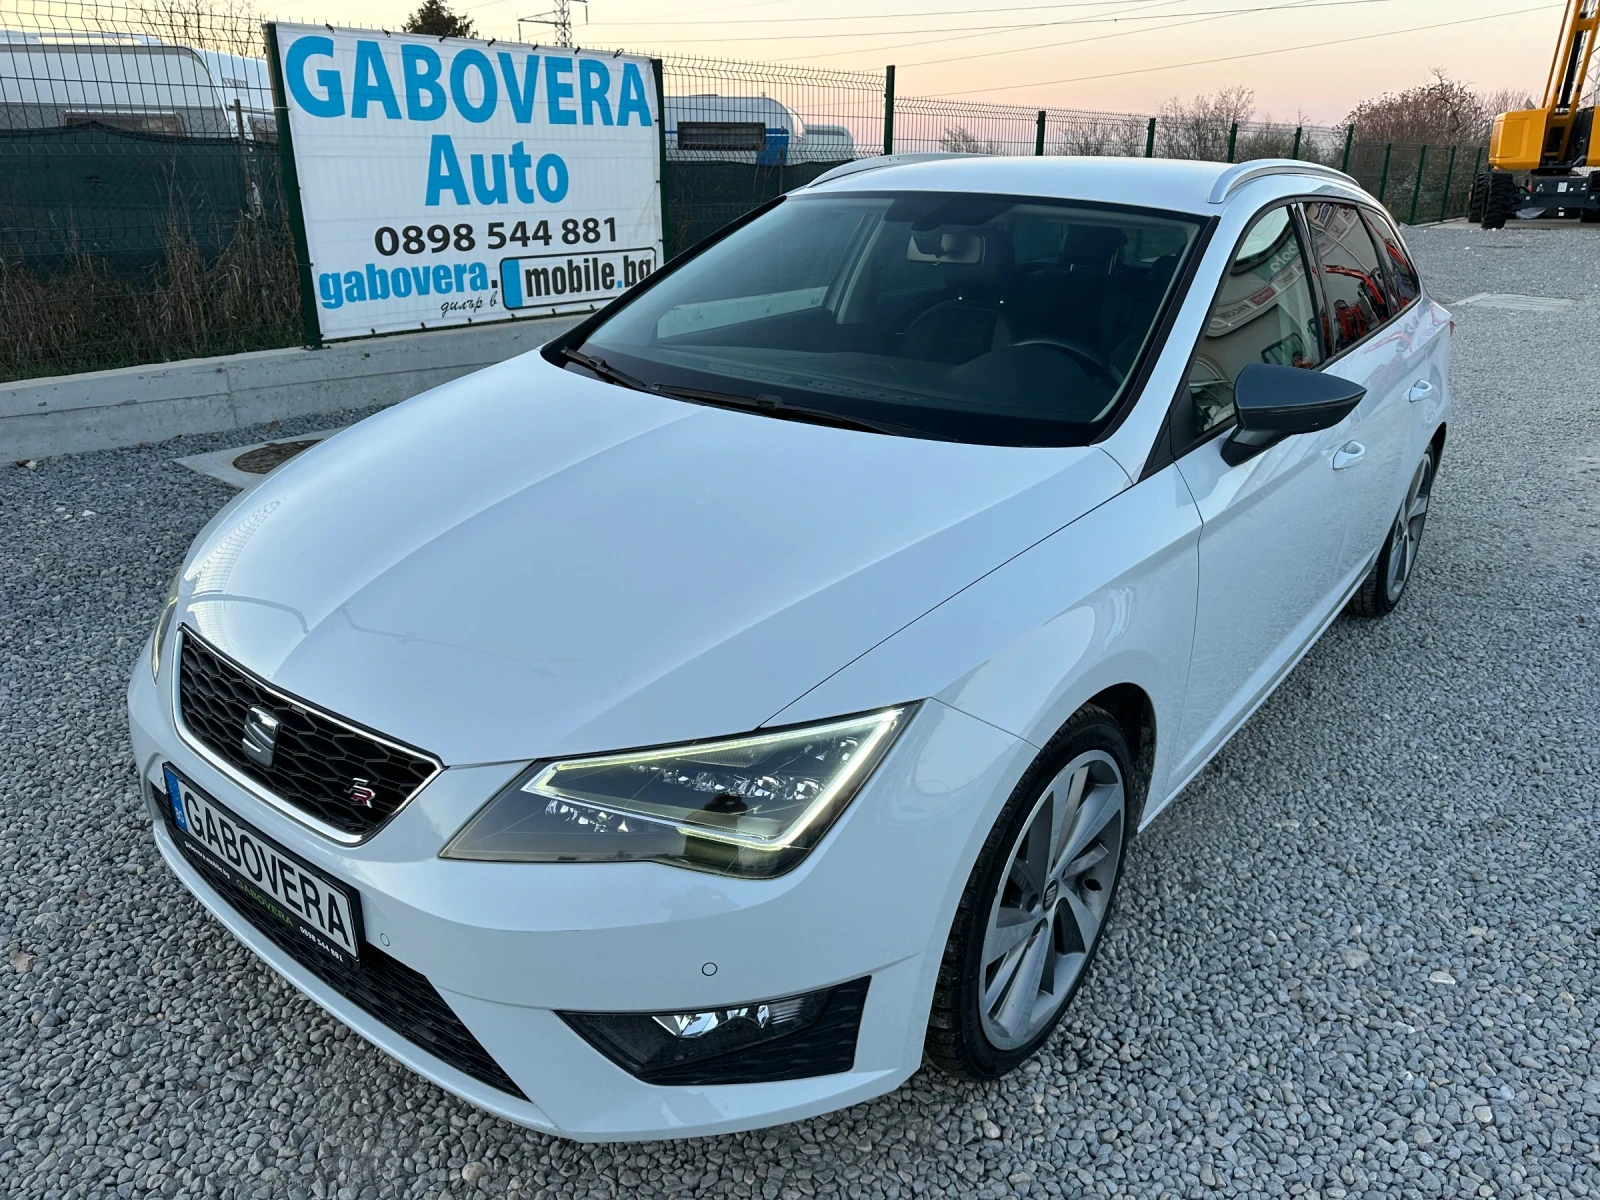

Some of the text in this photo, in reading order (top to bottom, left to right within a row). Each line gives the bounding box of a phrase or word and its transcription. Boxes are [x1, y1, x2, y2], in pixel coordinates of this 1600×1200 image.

[285, 35, 653, 127] GABOVERA
[425, 134, 569, 207] Auto
[374, 217, 617, 256] 0898 544 881
[440, 296, 484, 318] дилър
[183, 790, 352, 948] GABOVERA
[235, 879, 294, 928] GABOVERA
[299, 925, 317, 943] 0898
[316, 938, 330, 952] 544
[330, 948, 344, 963] 881
